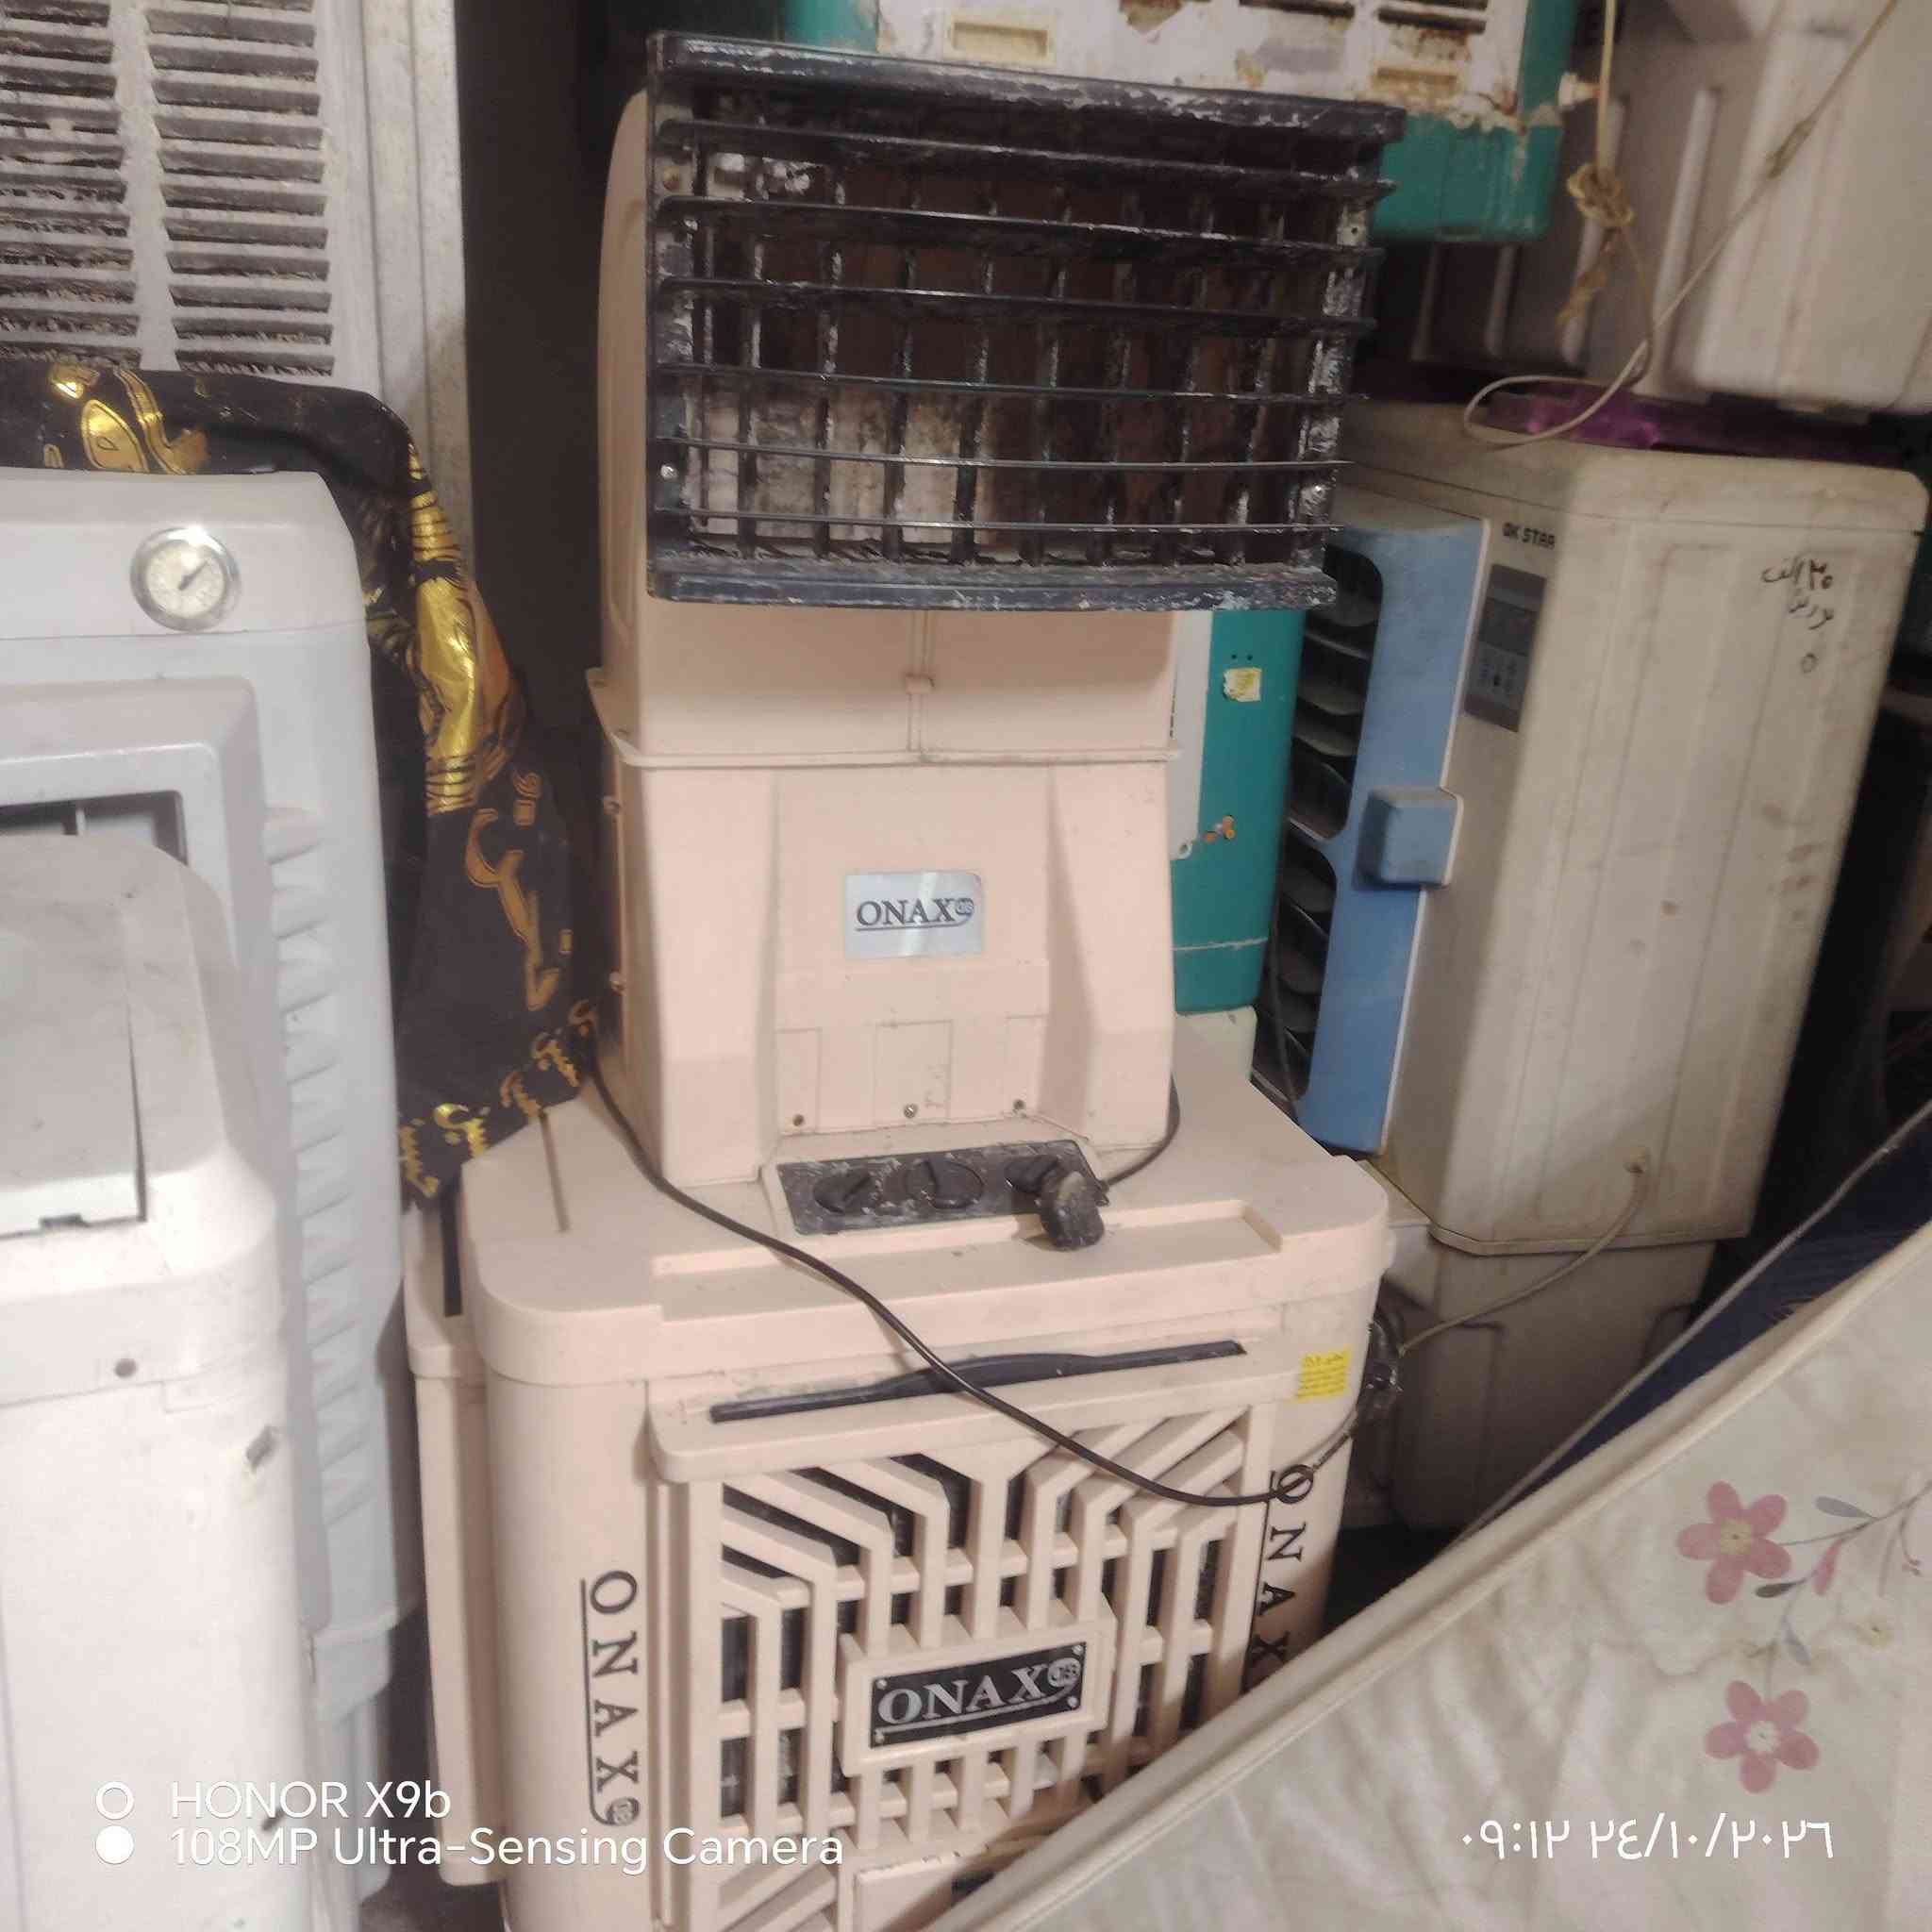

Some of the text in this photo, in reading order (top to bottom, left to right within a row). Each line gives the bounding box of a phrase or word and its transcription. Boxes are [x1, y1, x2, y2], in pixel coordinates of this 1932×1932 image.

[856, 898, 956, 926] ONAX
[590, 1570, 640, 1793] ONAX
[877, 1662, 1046, 1725] ONAX
